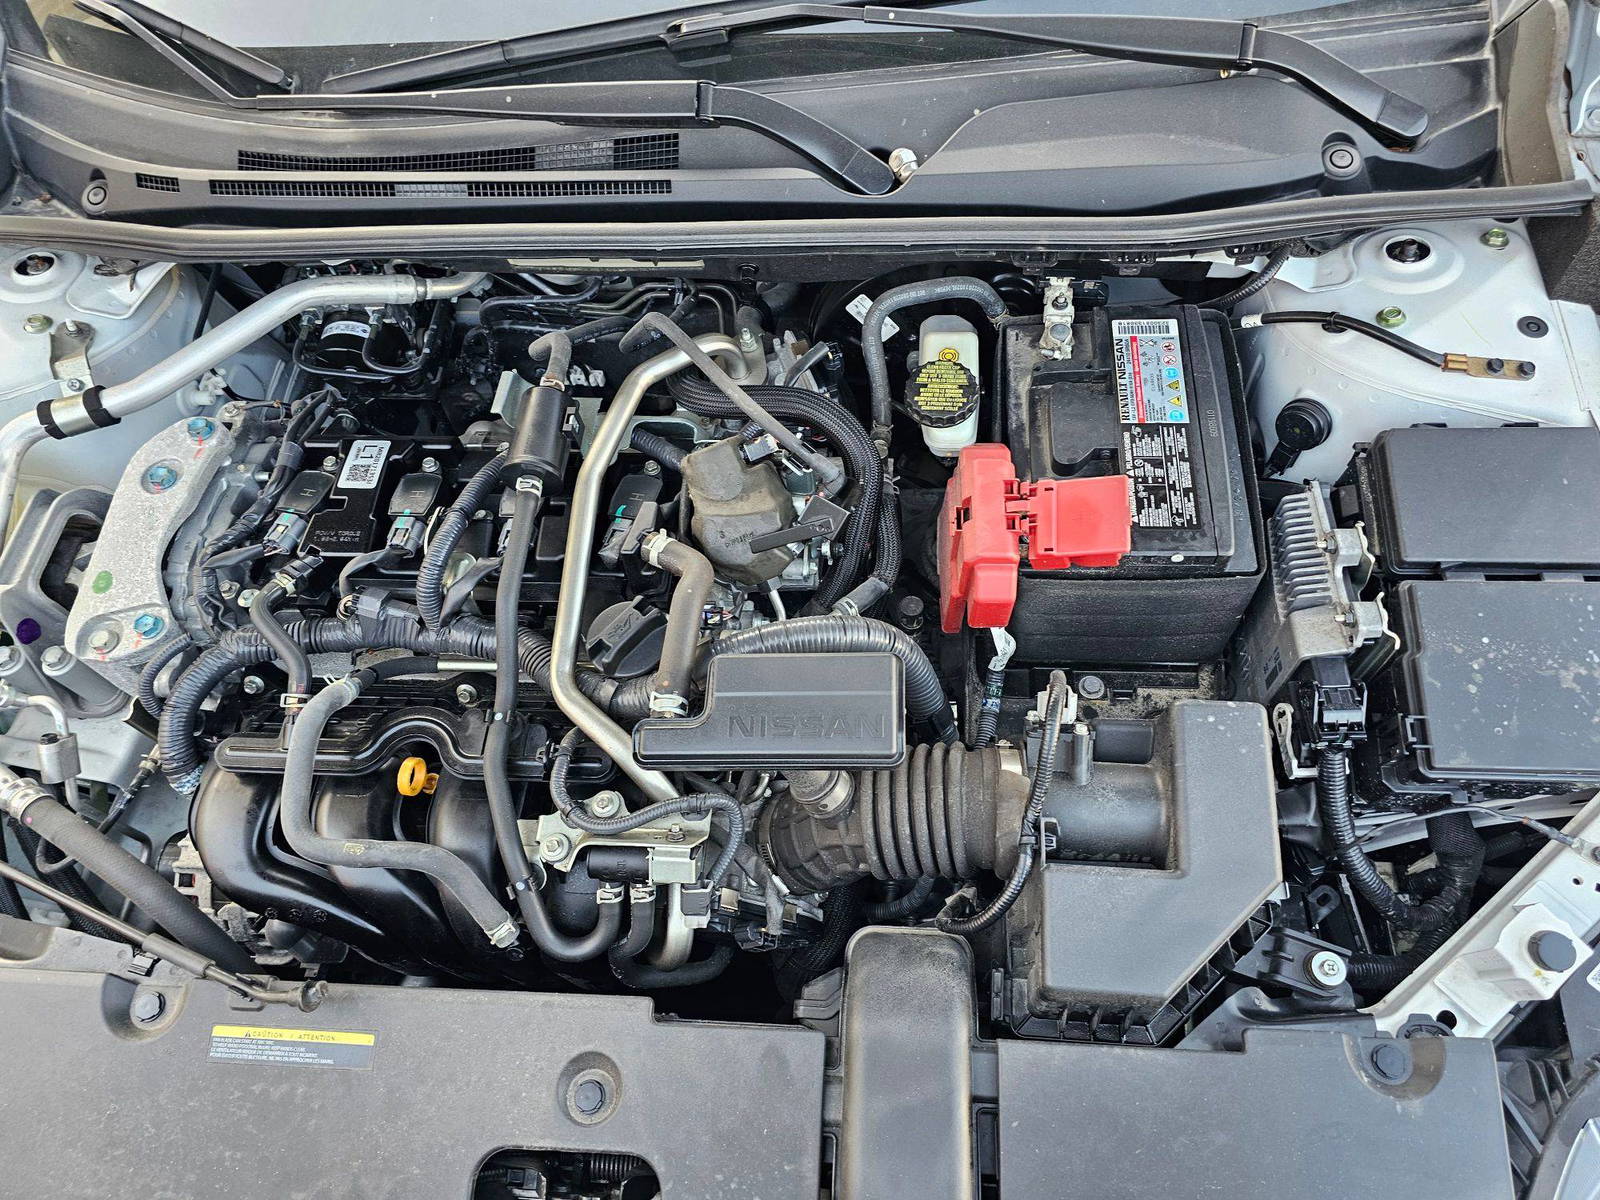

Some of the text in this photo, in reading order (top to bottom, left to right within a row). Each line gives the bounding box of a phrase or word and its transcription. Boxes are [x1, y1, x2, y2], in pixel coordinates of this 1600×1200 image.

[1115, 338, 1130, 421] RENAULT NISSAN
[360, 445, 378, 459] L1
[728, 714, 885, 738] NISSAN
[252, 1030, 284, 1038] CAUTION
